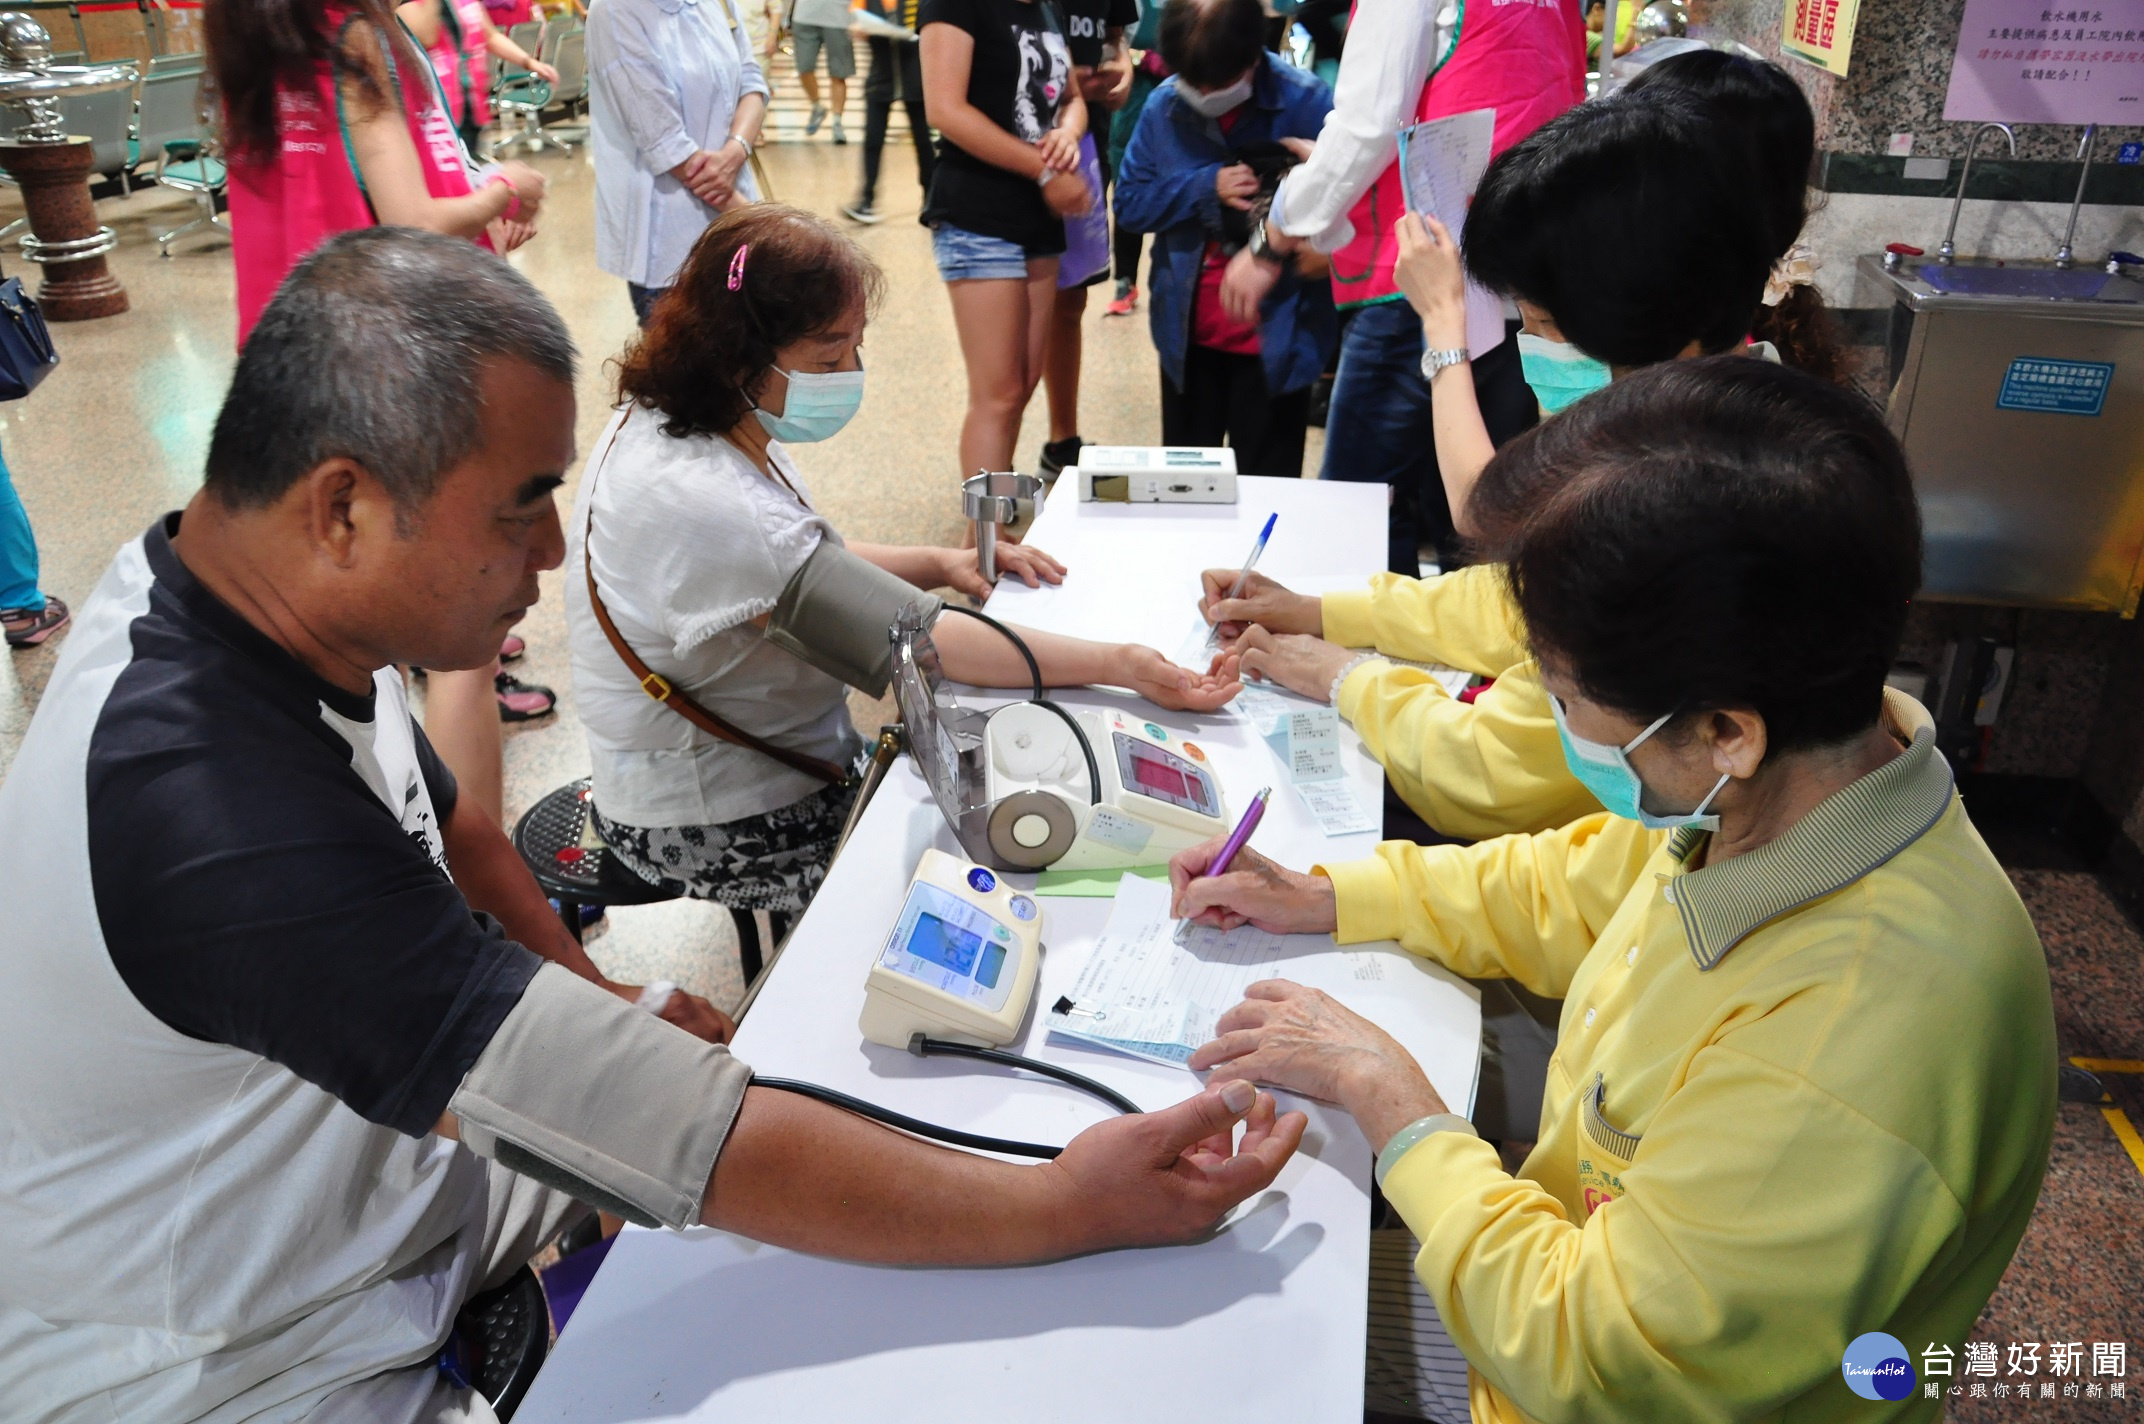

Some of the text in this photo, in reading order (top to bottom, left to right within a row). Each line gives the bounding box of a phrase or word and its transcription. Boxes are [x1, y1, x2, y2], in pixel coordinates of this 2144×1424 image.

[2041, 10, 2103, 22] 飲水機用水
[2124, 145, 2137, 156] 冷
[1017, 901, 1029, 919] START
